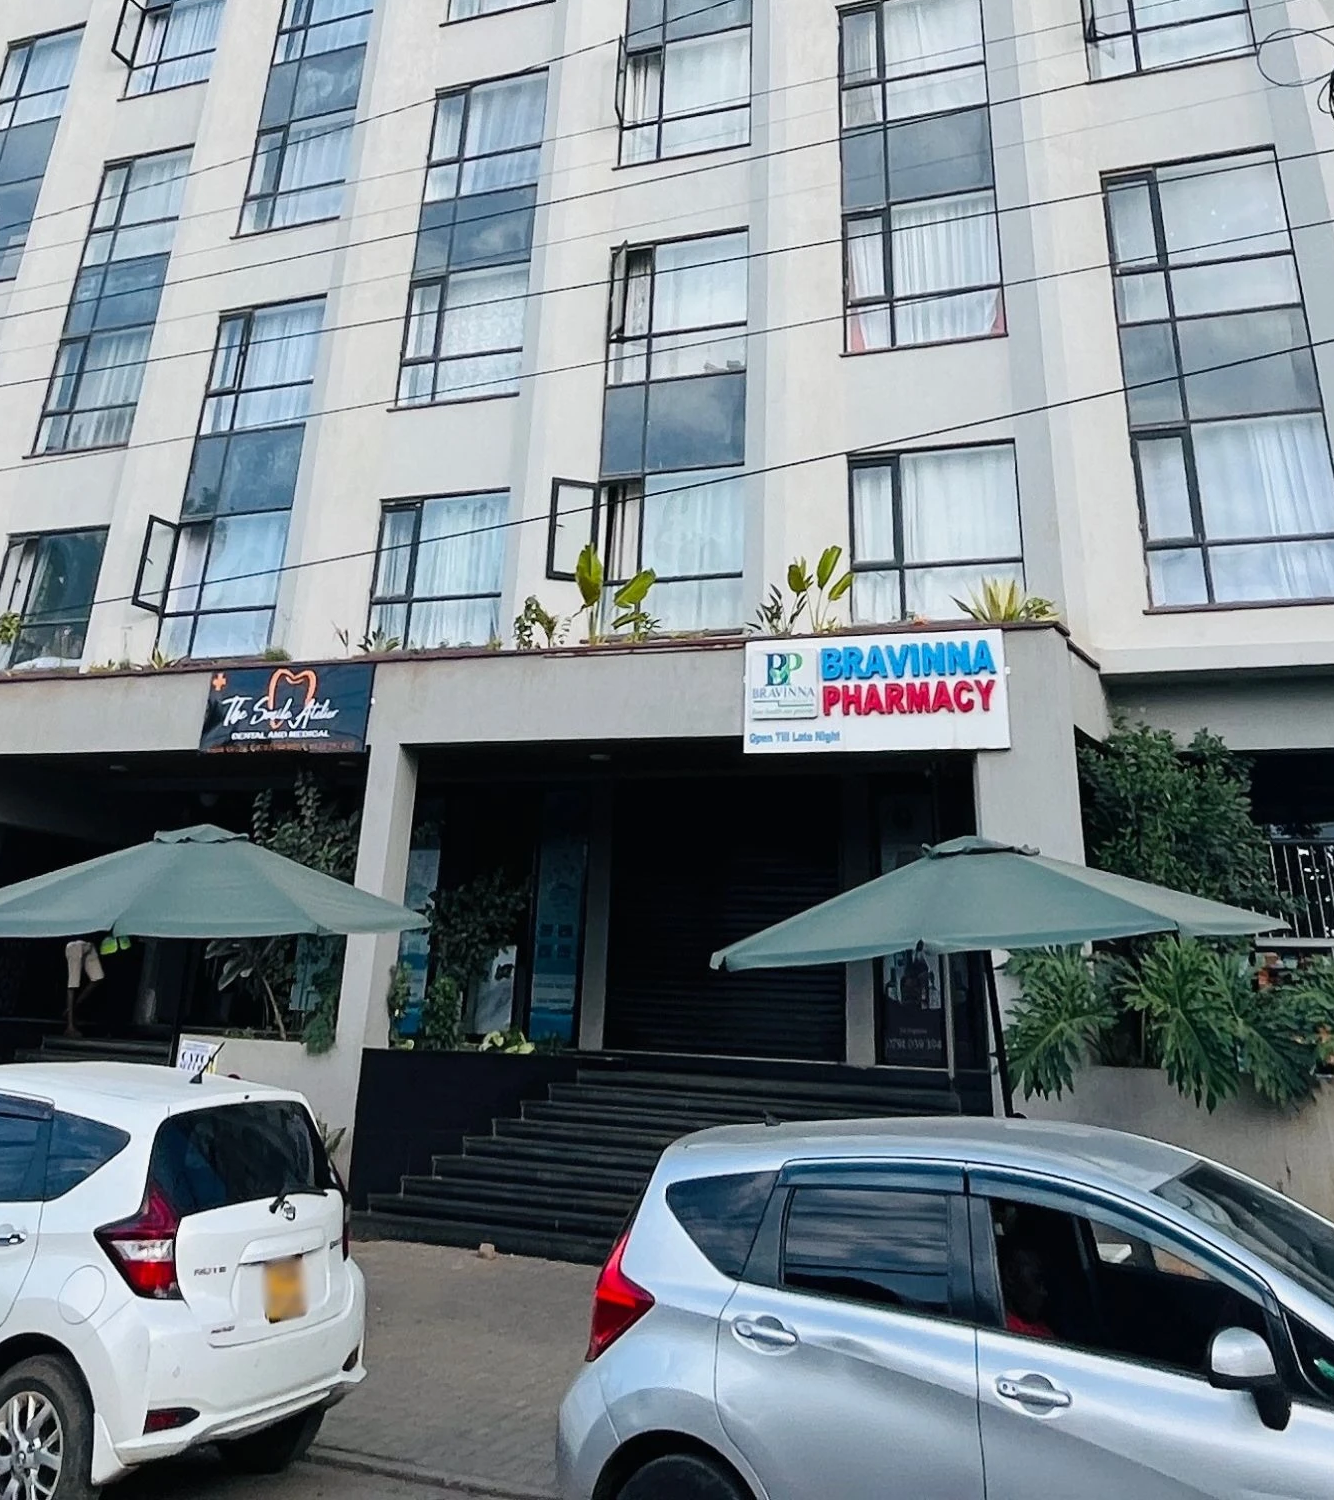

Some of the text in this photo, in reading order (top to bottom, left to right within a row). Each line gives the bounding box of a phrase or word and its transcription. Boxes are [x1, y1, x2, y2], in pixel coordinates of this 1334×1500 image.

[821, 640, 996, 681] BRAVINNA
[752, 686, 815, 699] BRAVINNA
[823, 680, 995, 716] PHARMACY
[221, 696, 340, 729] The Smile Atelier
[231, 728, 331, 741] DENTAL AND MEDICAL
[749, 730, 840, 744] Open Till Late Night
